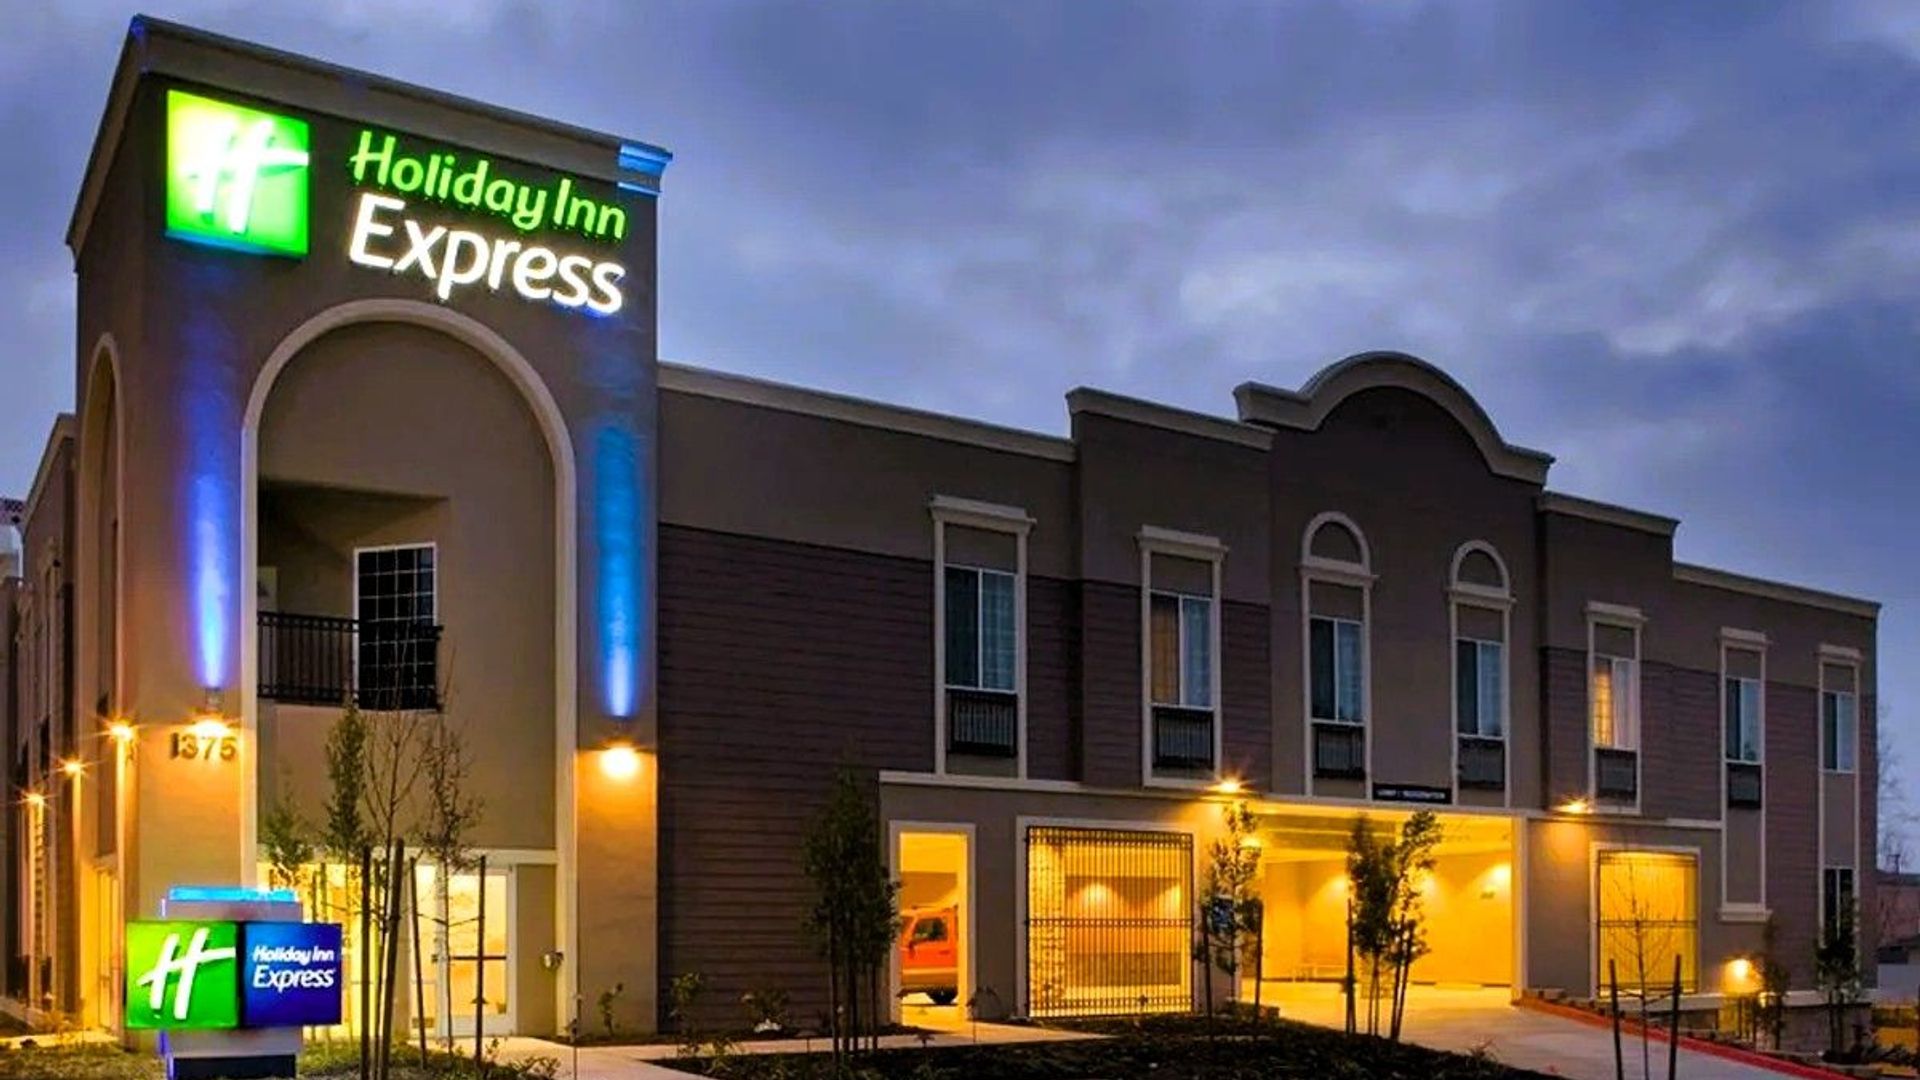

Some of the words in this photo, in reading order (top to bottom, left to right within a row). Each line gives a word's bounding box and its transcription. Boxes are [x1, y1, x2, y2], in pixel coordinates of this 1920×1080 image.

[349, 130, 547, 231] Holiday
[554, 178, 626, 239] Inn
[349, 192, 626, 315] Express
[170, 732, 237, 761] 1375
[253, 945, 311, 966] Holiday
[312, 946, 335, 962] Inn
[253, 965, 335, 993] Express
